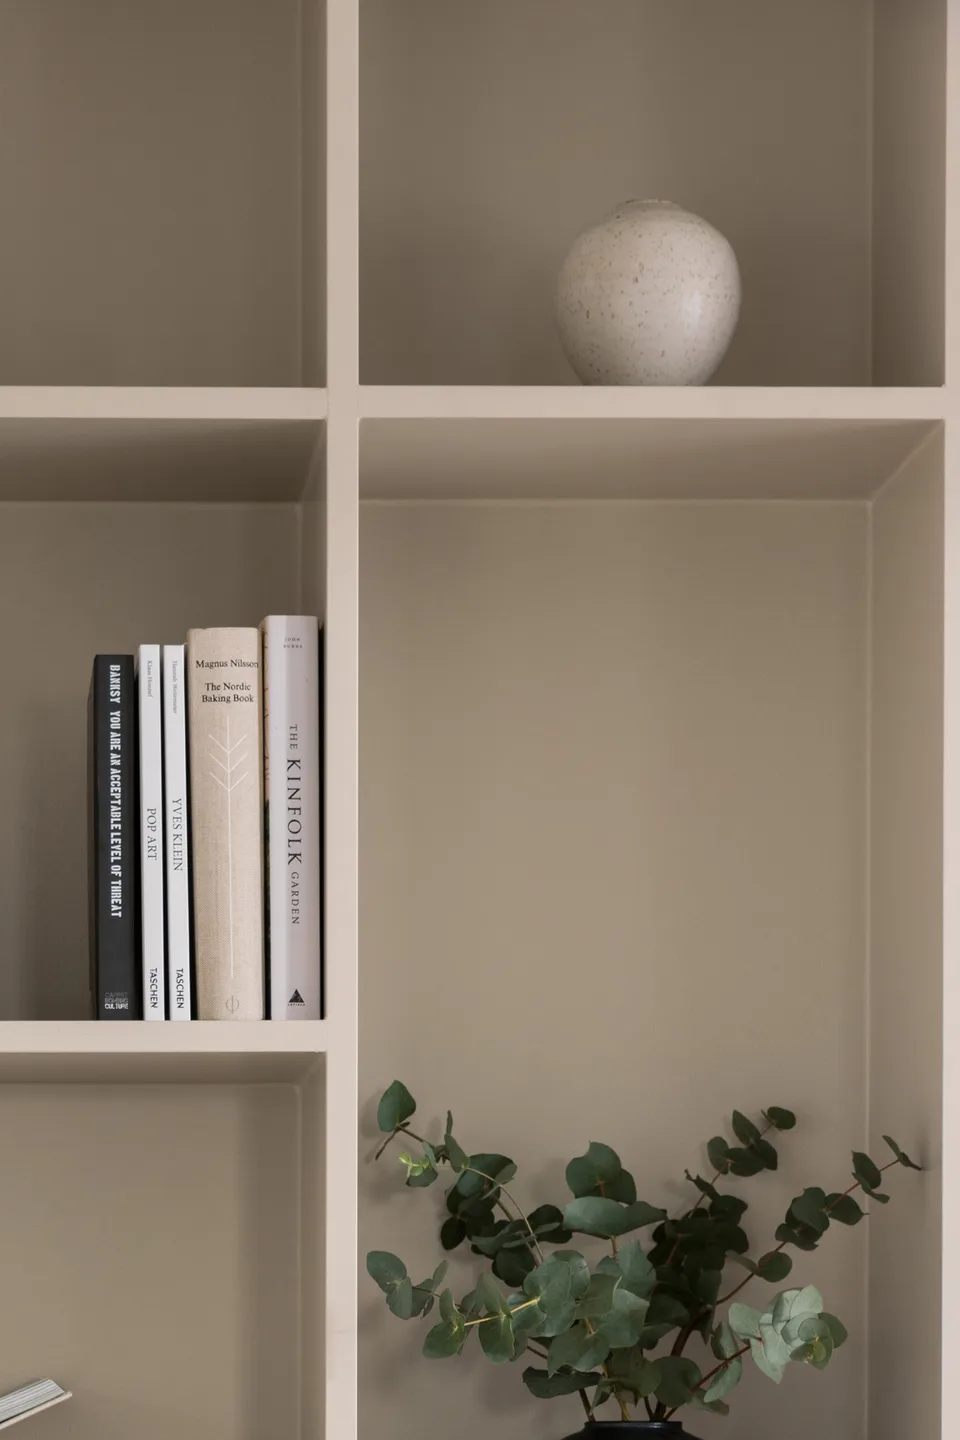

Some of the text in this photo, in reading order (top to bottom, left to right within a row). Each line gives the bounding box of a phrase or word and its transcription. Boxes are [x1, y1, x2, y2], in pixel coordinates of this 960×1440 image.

[195, 659, 259, 669] Magnus Nilsson
[201, 693, 254, 704] Baking Book
[205, 681, 251, 691] The Nordic
[109, 664, 122, 918] BANKSY YOU ARE AN ACCEPTABLE LEVEL OF THREAT
[146, 808, 158, 861] POP ART
[172, 798, 184, 872] YVES KLEIN
[286, 724, 302, 925] THE KINFOLK GARDEN
[149, 967, 158, 1009] TASCHEN
[176, 967, 185, 1009] TASCHEN
